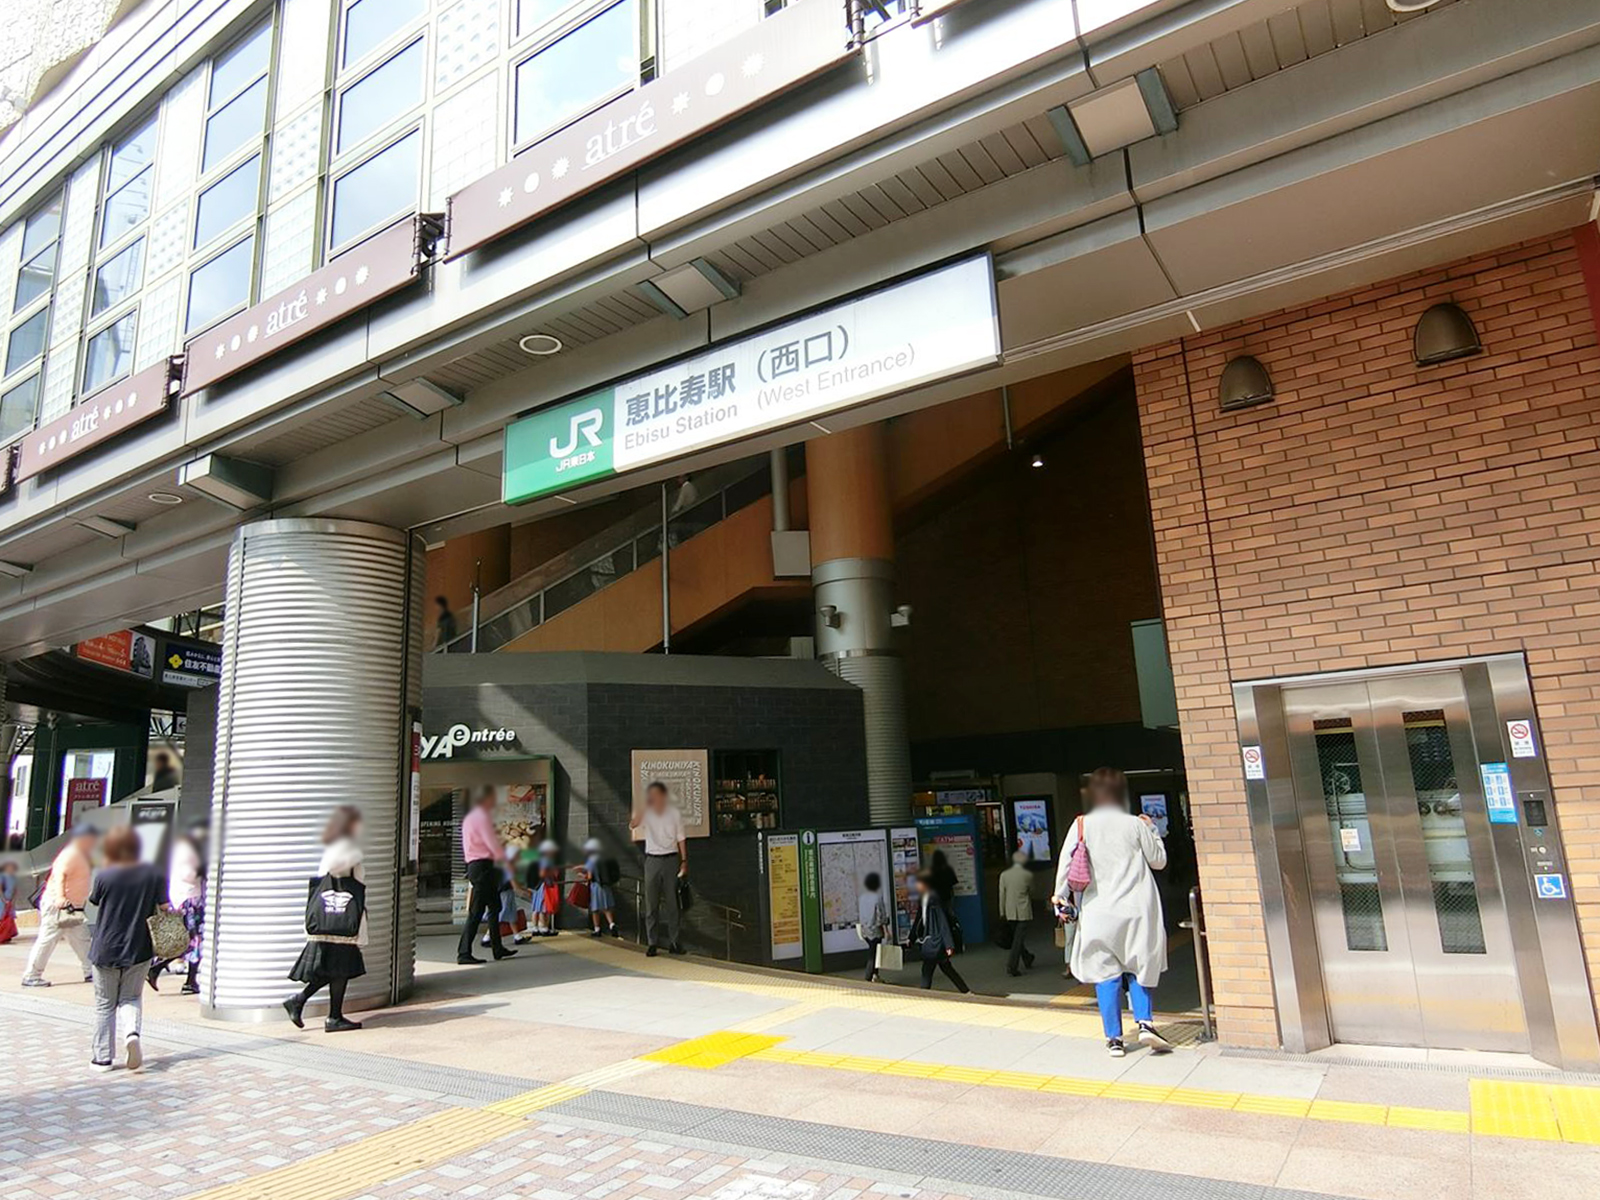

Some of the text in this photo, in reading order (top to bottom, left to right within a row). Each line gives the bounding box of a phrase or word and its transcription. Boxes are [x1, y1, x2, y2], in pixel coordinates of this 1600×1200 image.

[583, 100, 656, 166] atré
[265, 290, 309, 334] atré
[624, 343, 915, 450] Ebisu Station (West Entrance)
[625, 362, 737, 427] 恵比寿駅
[70, 405, 99, 440] atré
[549, 408, 603, 458] JR
[448, 723, 516, 746] entrée
[641, 760, 693, 769] KINOKUNIYA
